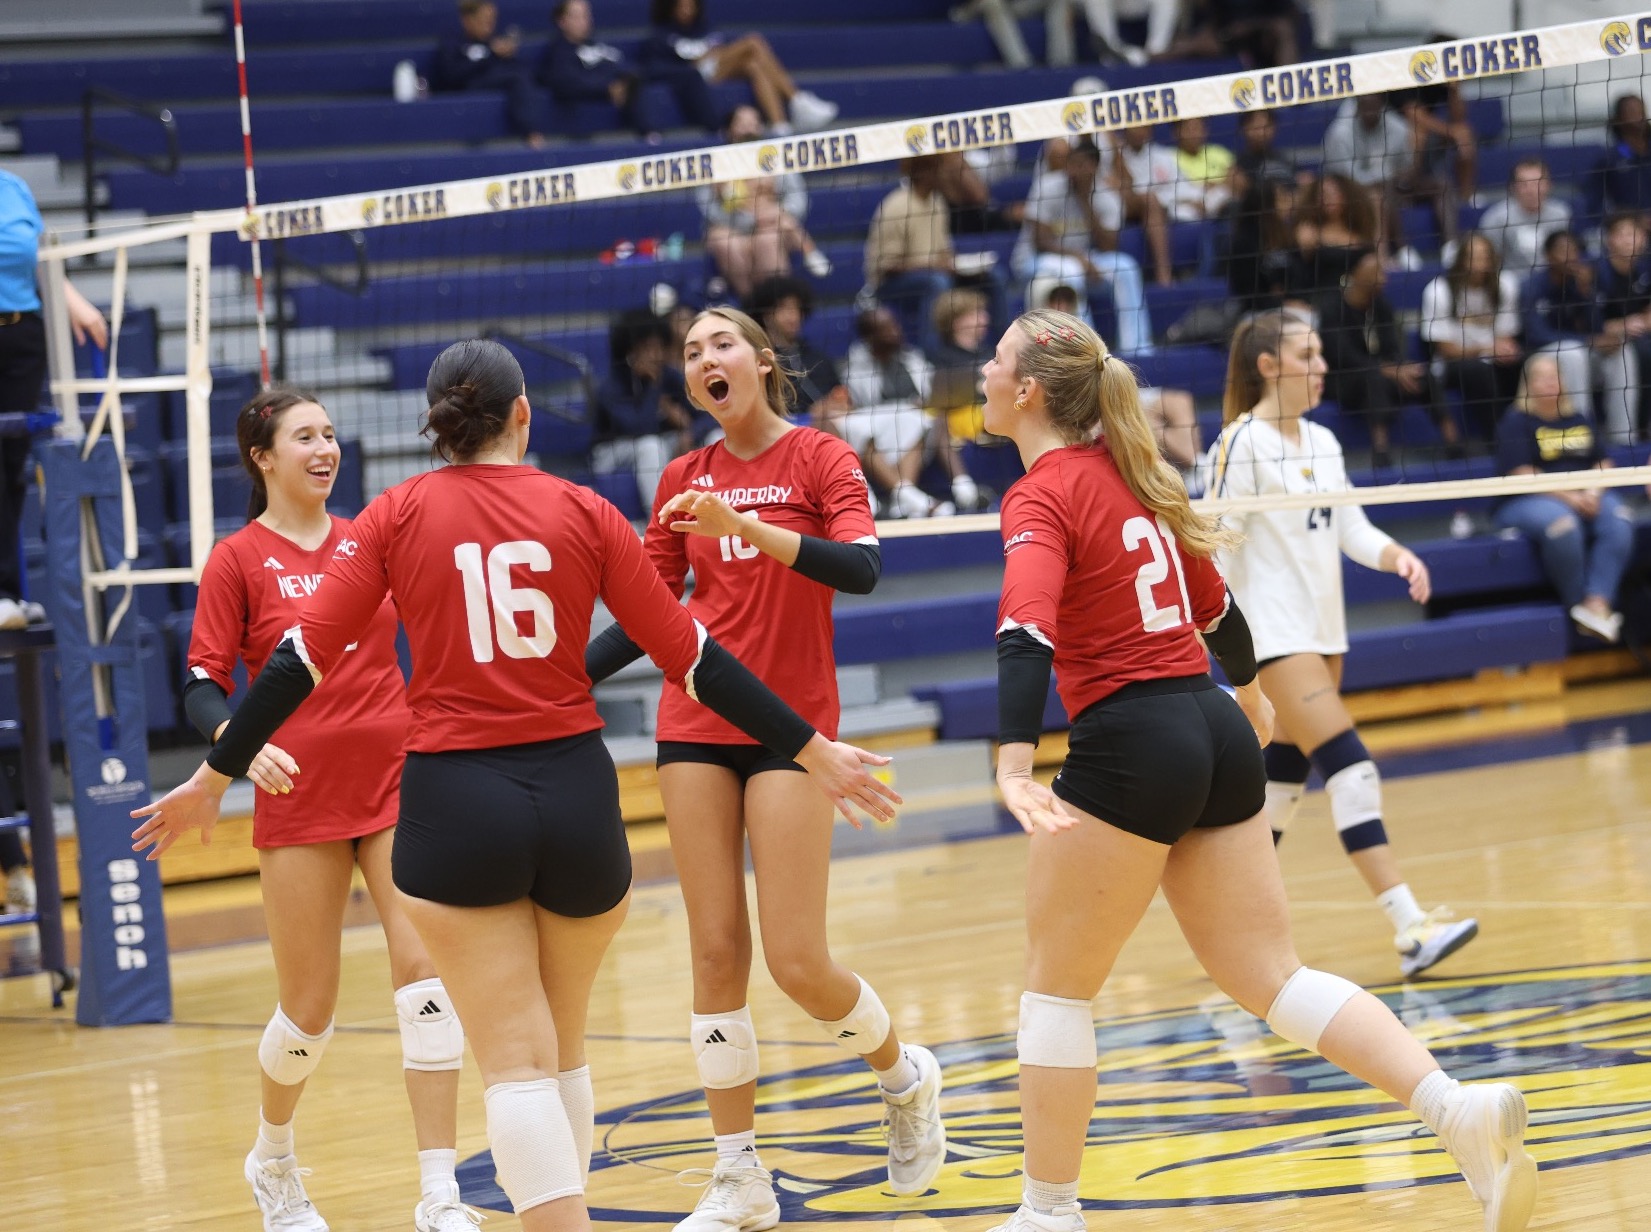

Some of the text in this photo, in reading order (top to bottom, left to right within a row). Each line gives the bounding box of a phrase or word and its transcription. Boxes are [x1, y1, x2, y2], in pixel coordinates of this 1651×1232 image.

[265, 205, 324, 238] COKER
[383, 189, 446, 224] COKER
[509, 173, 576, 205] COKER
[642, 154, 714, 187] COKER
[783, 134, 860, 169] COKER
[931, 112, 1014, 150] COKER
[1091, 87, 1179, 127] COKER
[1260, 63, 1355, 106] COKER
[1441, 34, 1542, 79] COKER
[335, 538, 358, 556] AC
[713, 485, 792, 507] WBERRY
[453, 540, 558, 663] 16
[1121, 513, 1192, 633] 21
